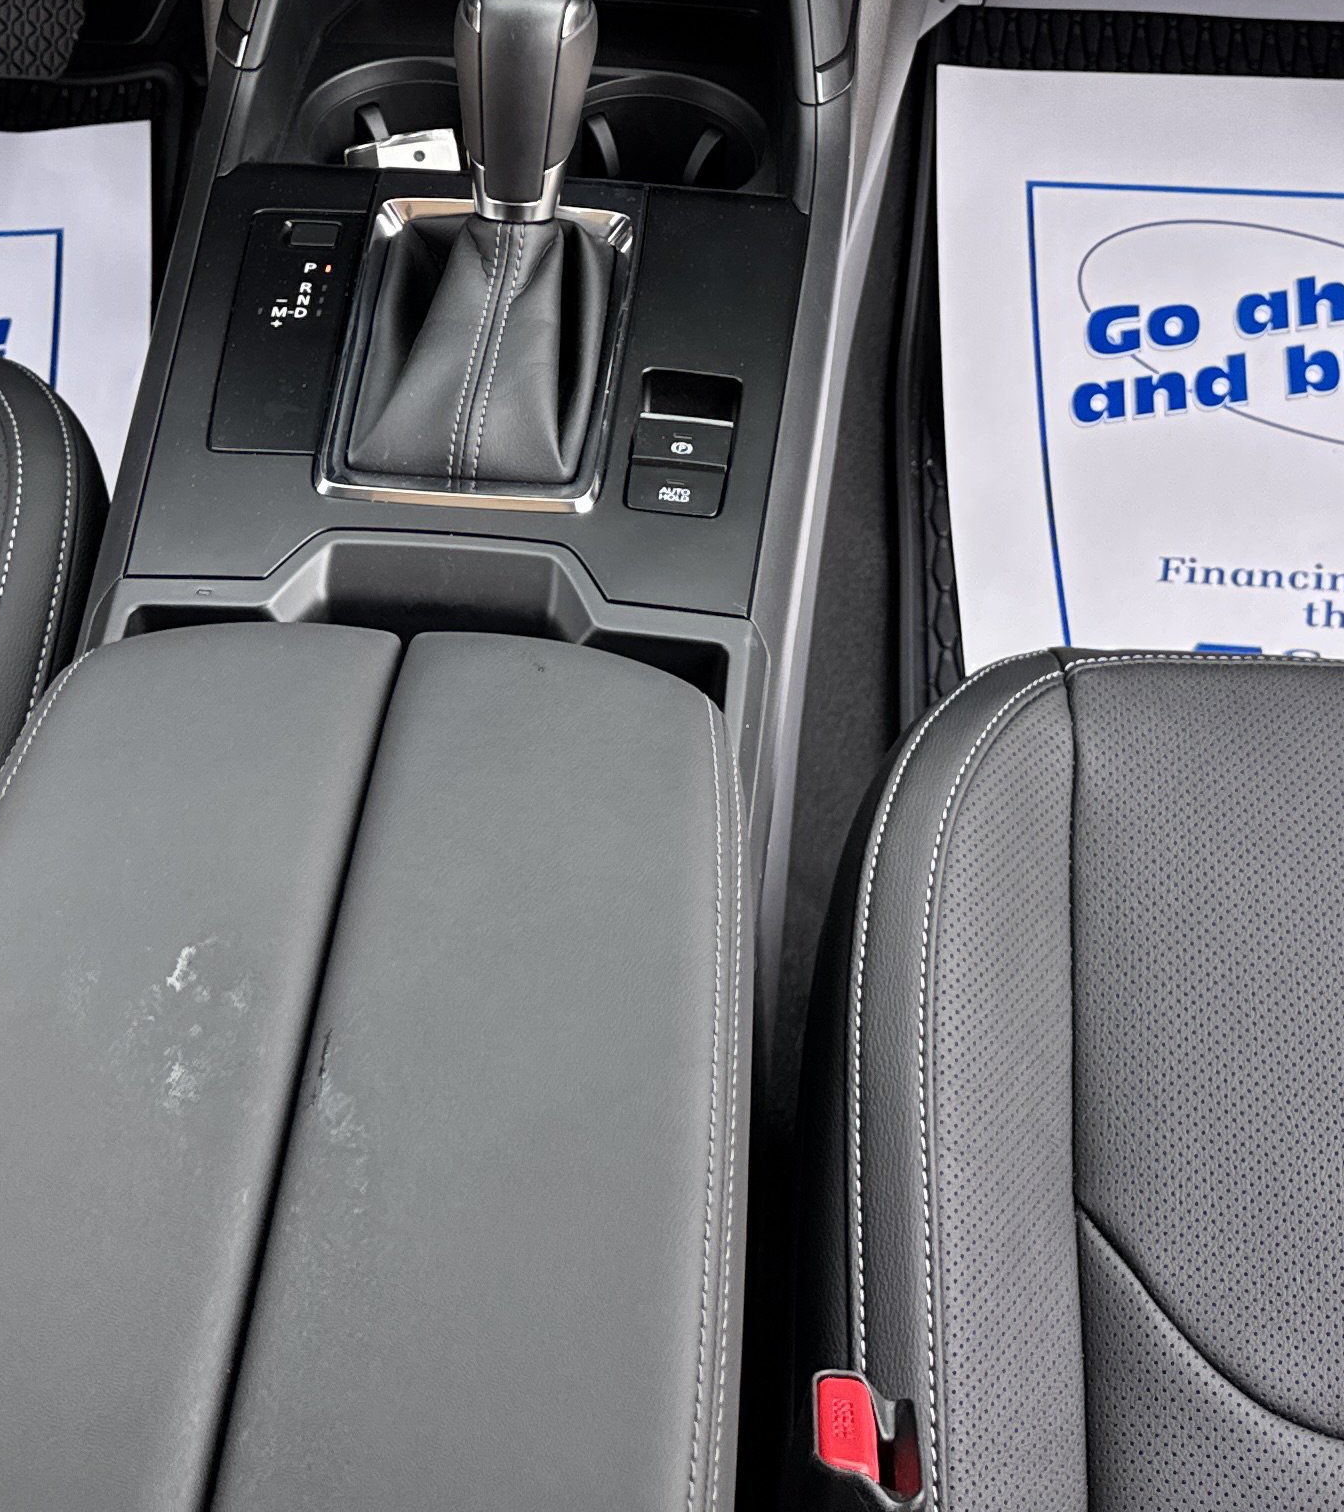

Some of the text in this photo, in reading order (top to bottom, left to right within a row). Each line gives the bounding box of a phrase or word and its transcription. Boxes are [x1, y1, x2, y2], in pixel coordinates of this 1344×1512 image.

[303, 262, 317, 274] P
[299, 282, 312, 294] R
[296, 294, 311, 306] N
[1086, 302, 1201, 358] Go
[1070, 353, 1249, 427] and
[659, 486, 691, 496] AUTO
[658, 493, 690, 503] HOLD
